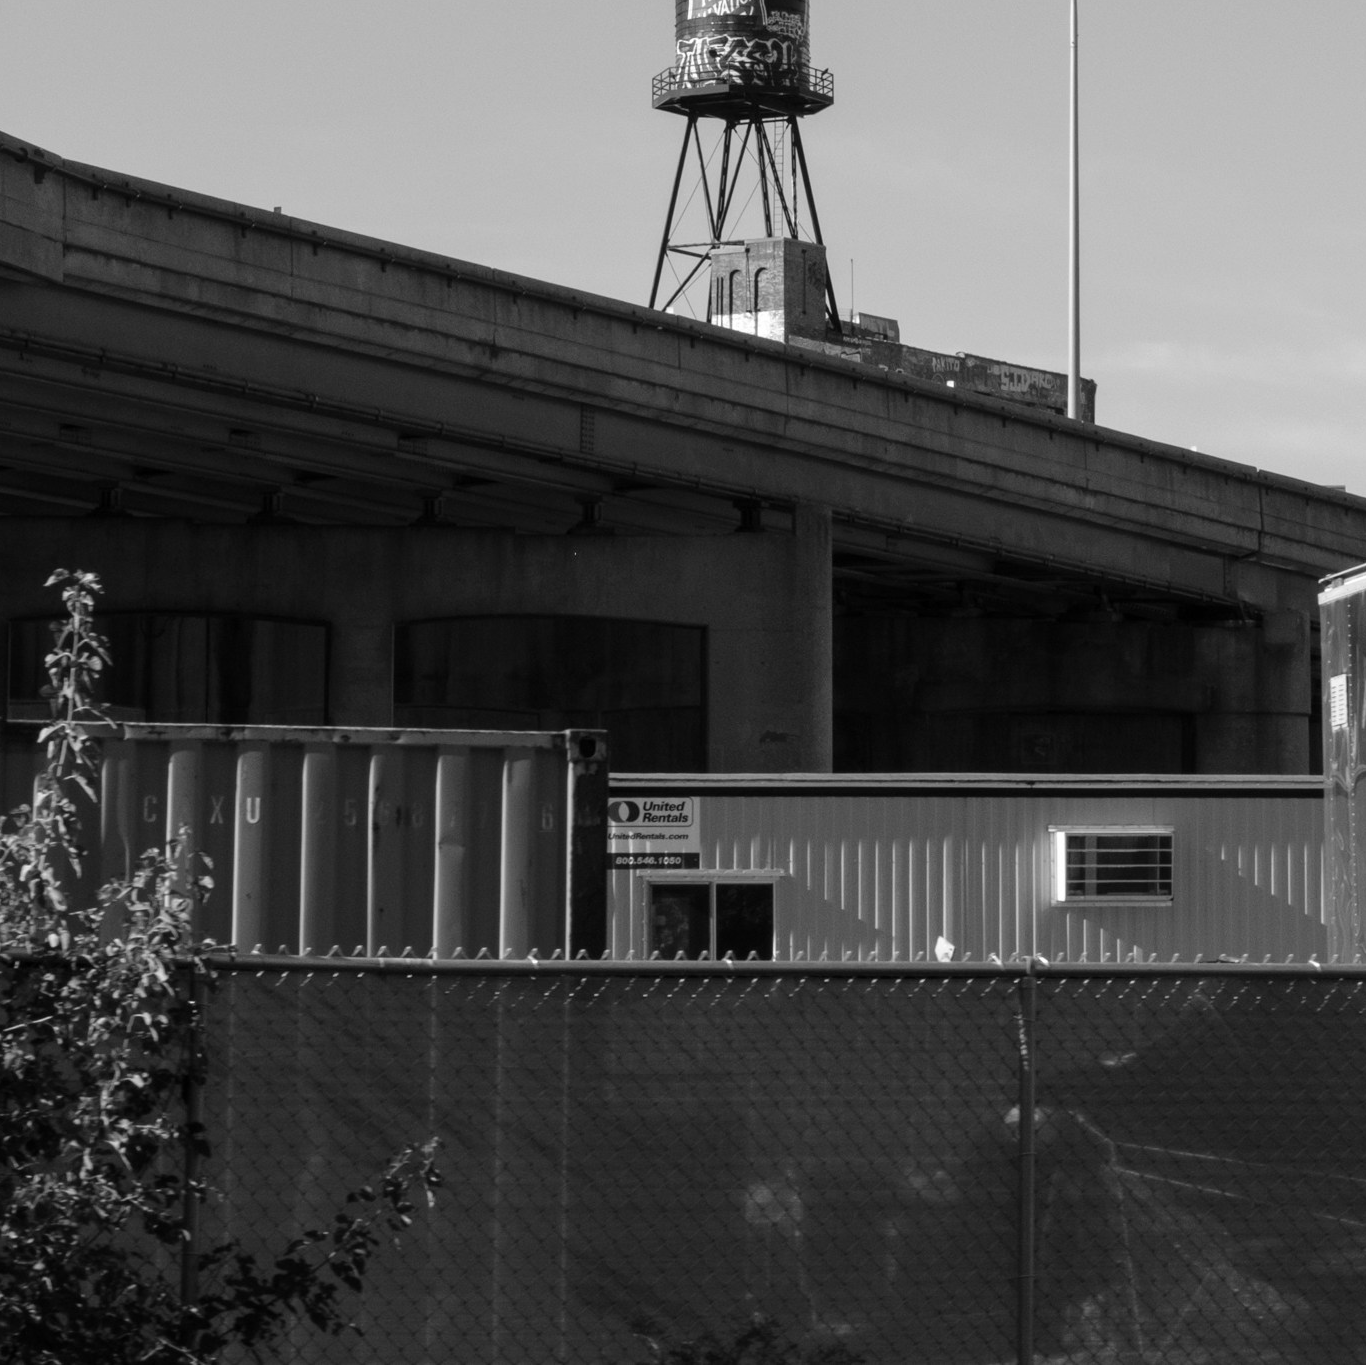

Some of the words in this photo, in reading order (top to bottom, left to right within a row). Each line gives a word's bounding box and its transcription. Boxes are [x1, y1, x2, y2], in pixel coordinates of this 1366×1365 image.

[642, 801, 686, 812] United
[642, 812, 689, 823] Rentals
[607, 832, 689, 841] UnitedRentals.com
[615, 856, 682, 865] 800.546.1050
